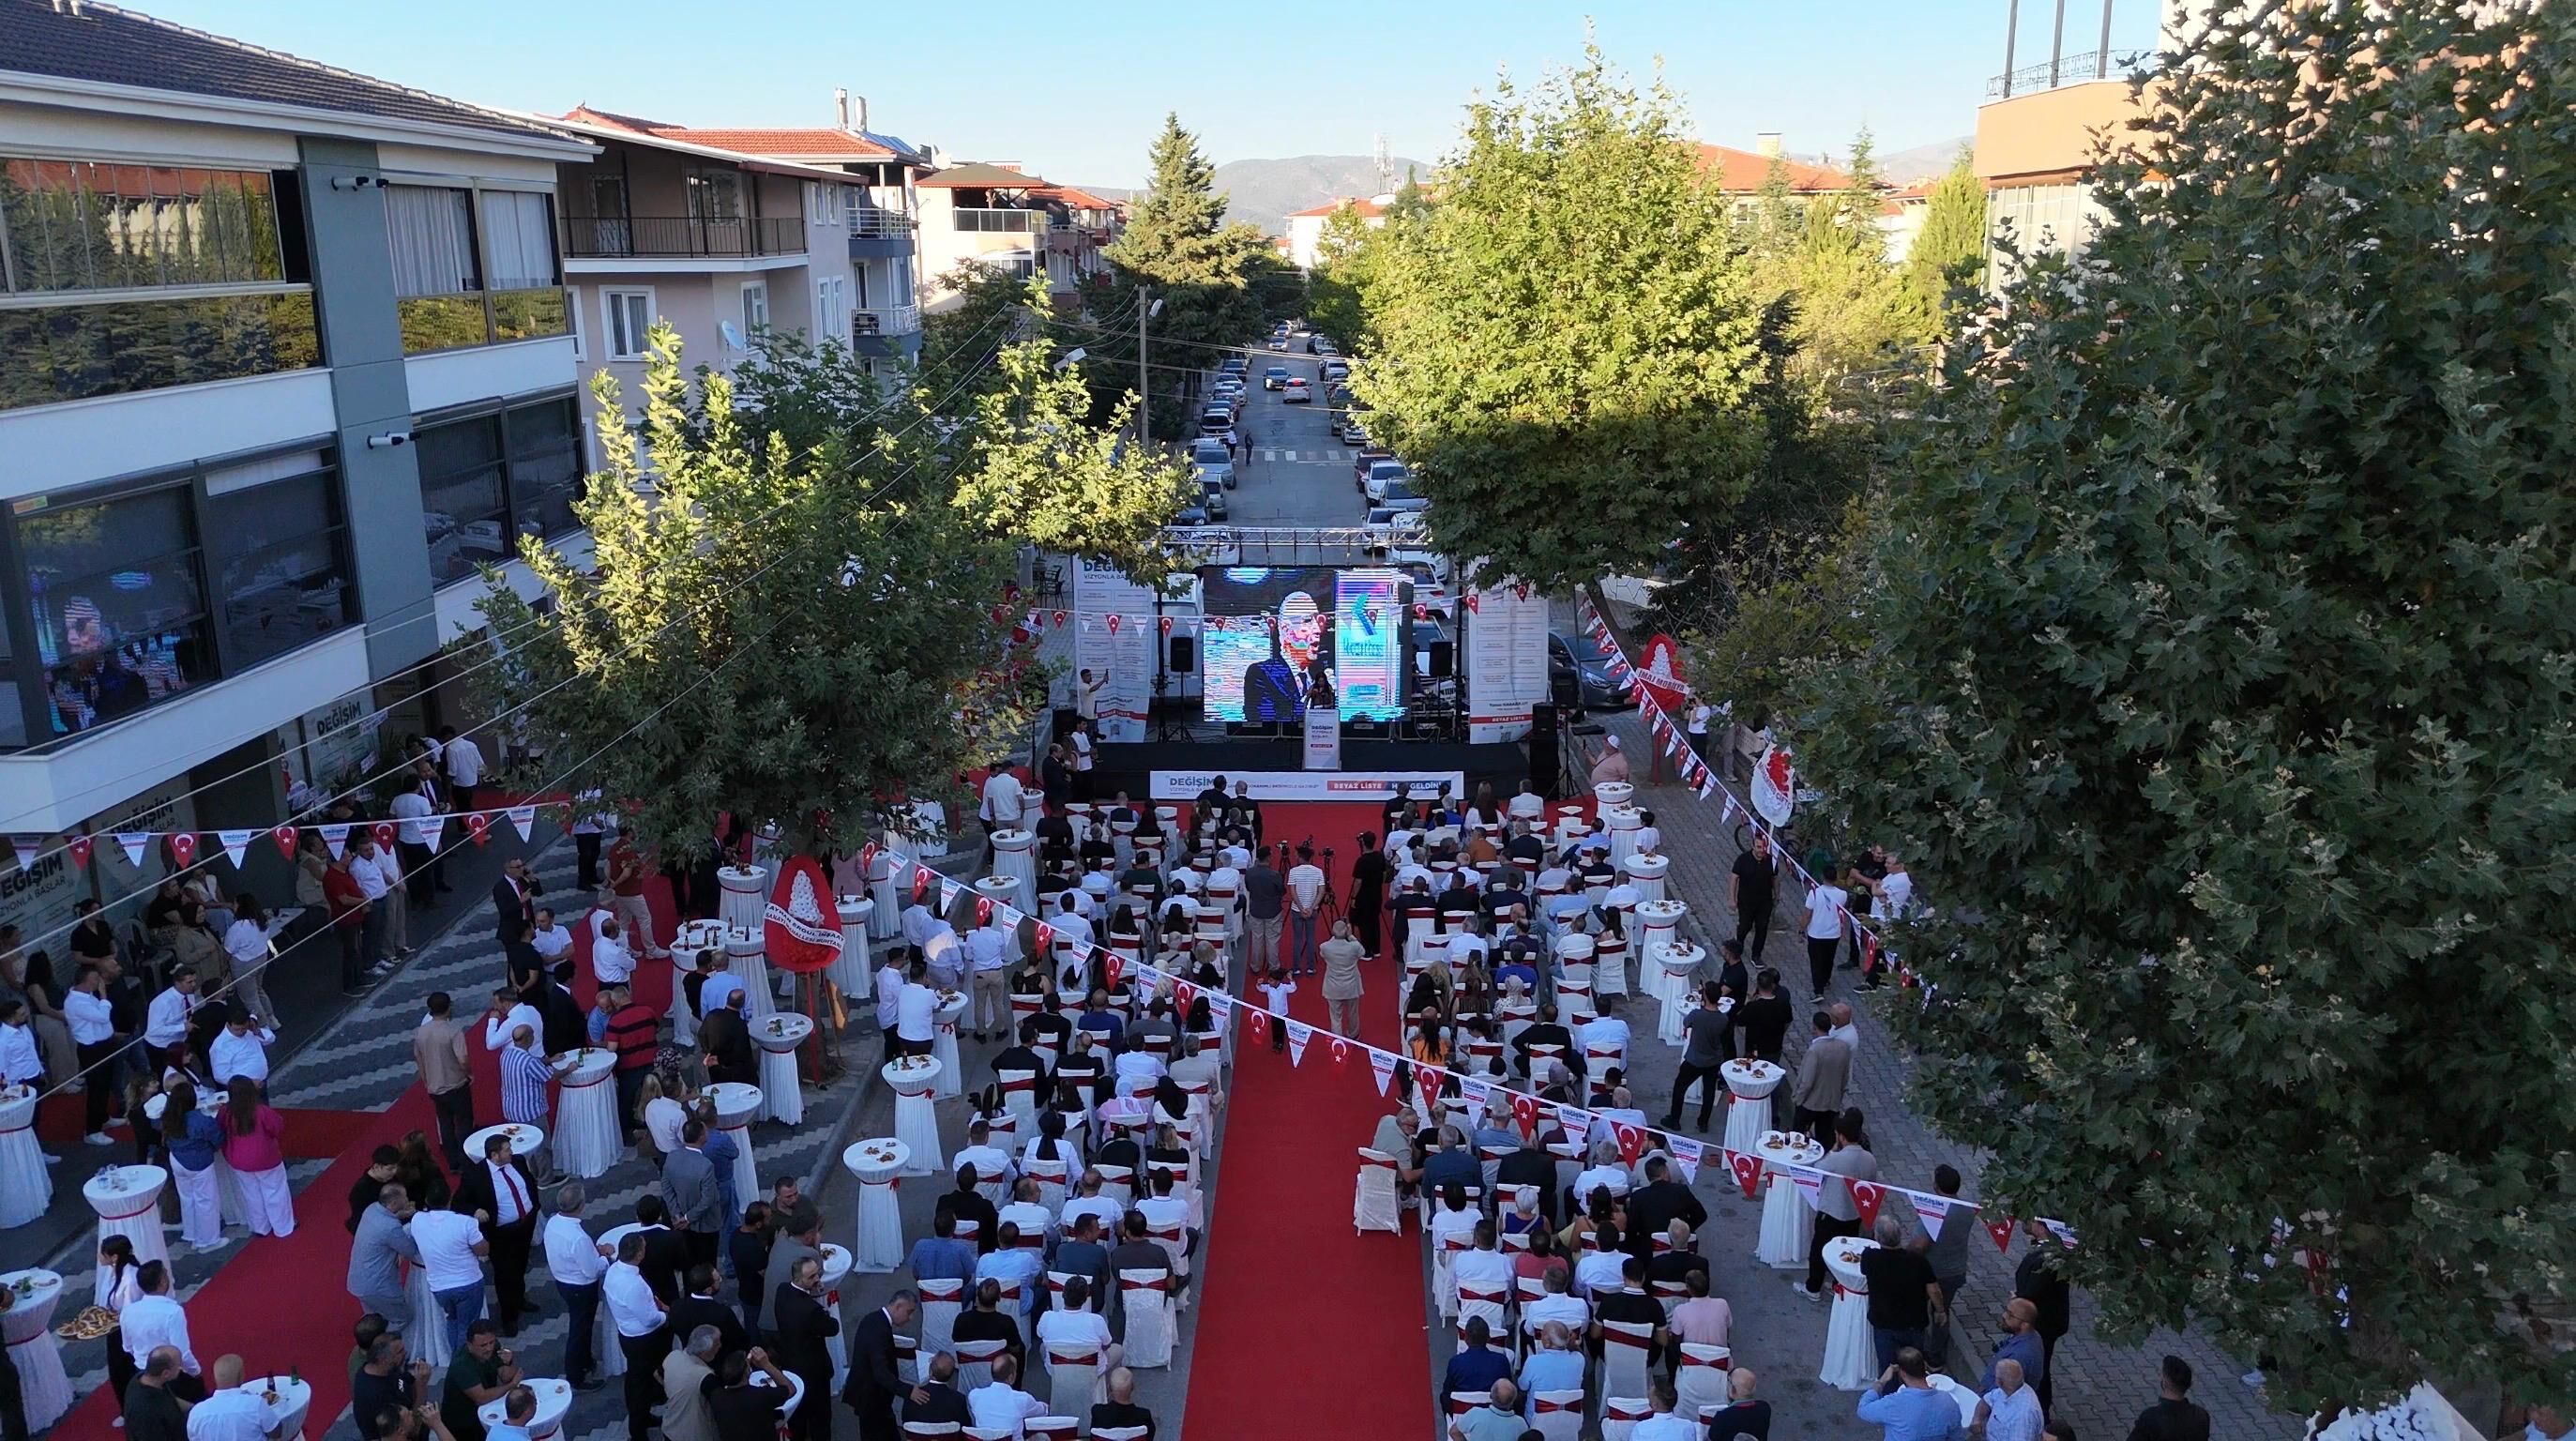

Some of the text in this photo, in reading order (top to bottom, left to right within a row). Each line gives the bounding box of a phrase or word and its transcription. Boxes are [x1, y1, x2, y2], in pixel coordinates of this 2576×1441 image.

[316, 700, 361, 736] DEĞİŞİM
[1170, 775, 1215, 787] DEĞİŞİM
[1410, 781, 1442, 790] GELDİN
[0, 851, 64, 900] EĞİŞİM
